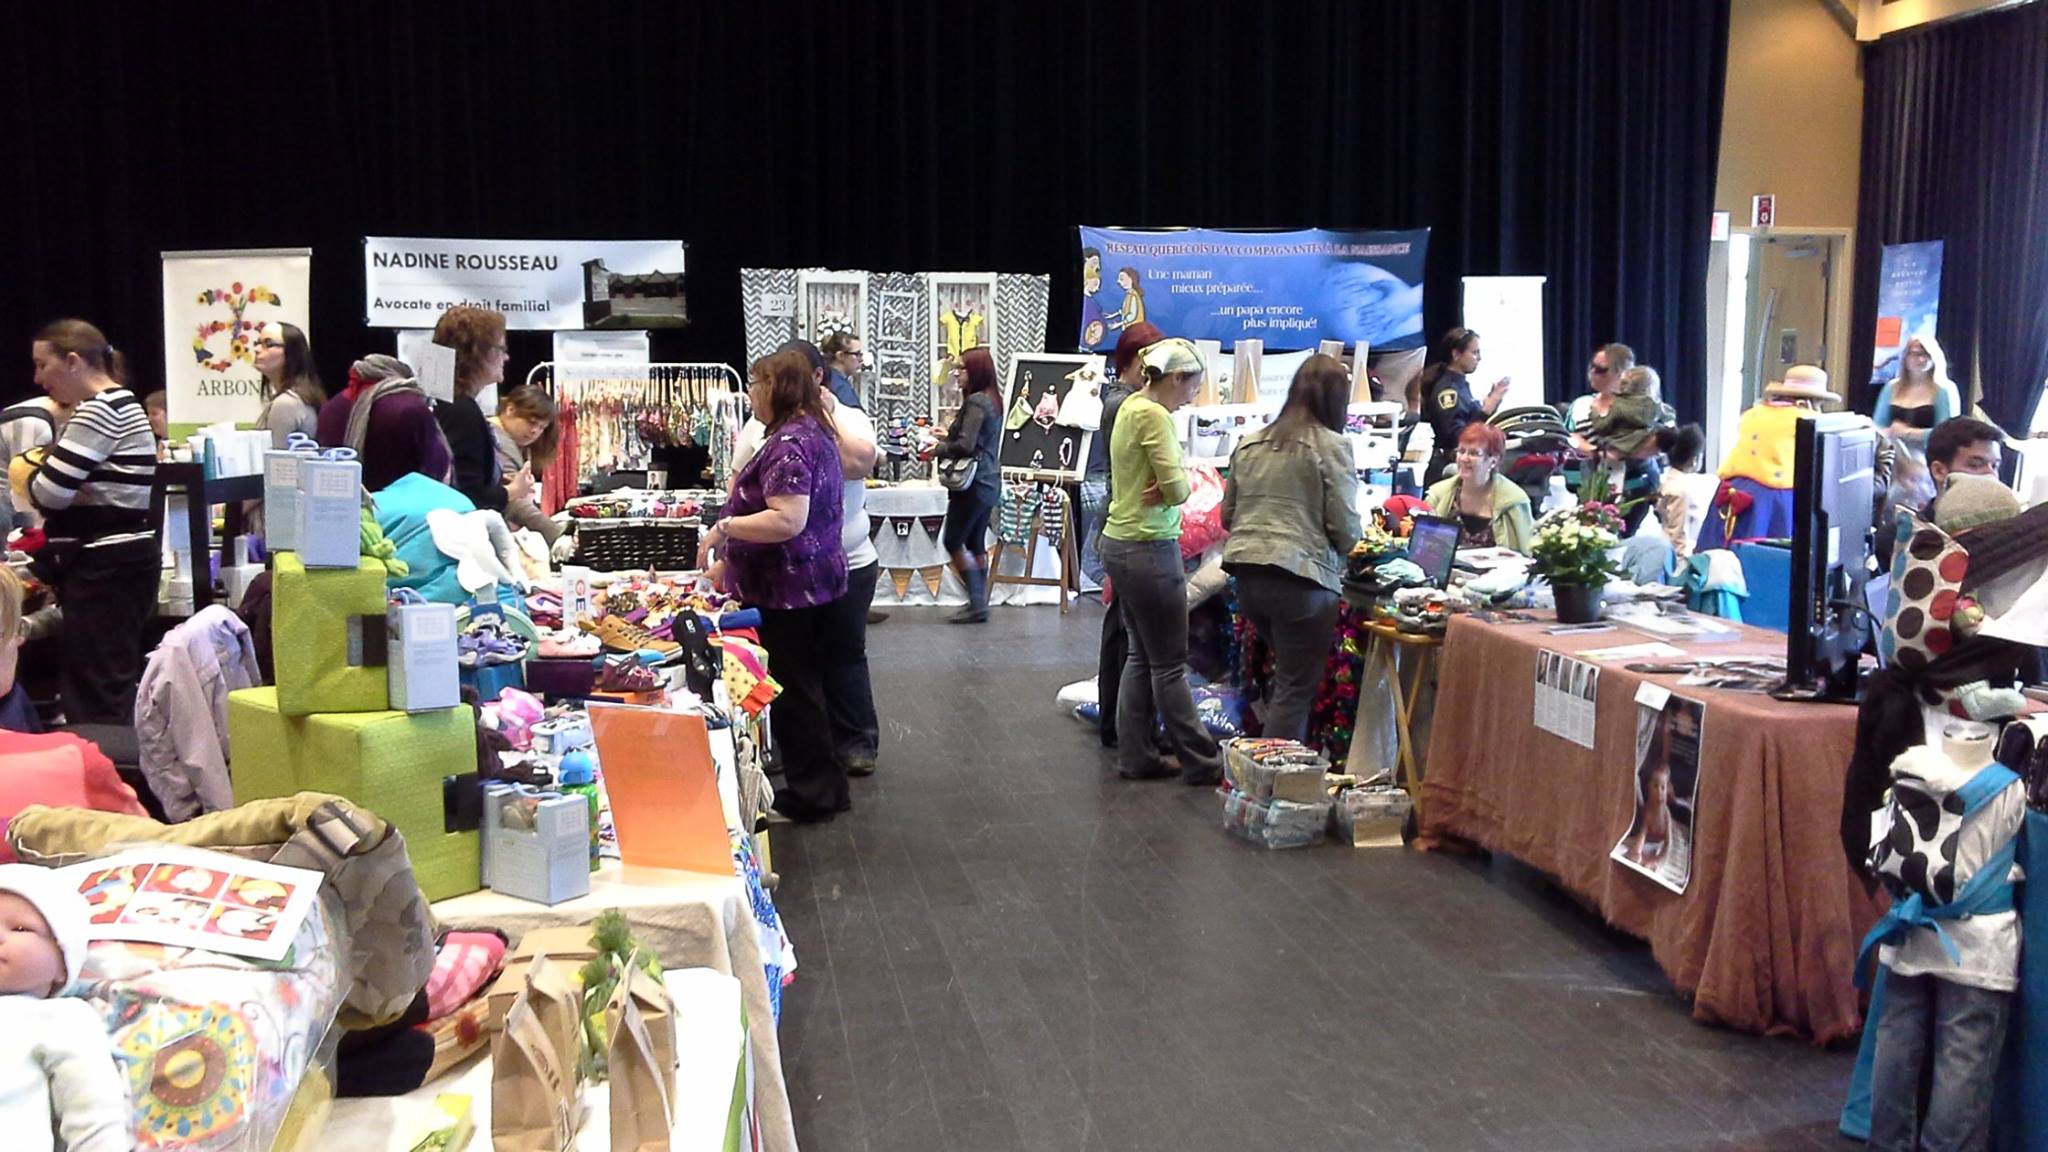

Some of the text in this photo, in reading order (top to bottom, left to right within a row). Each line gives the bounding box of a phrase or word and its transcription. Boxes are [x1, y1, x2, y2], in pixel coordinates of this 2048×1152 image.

[373, 252, 559, 271] NADINE ROUSSEAU
[1148, 269, 1212, 280] Une maman
[1171, 283, 1204, 294] mieux
[373, 298, 432, 310] Avocate
[495, 299, 551, 312] familial
[1236, 306, 1264, 317] papa
[1266, 306, 1303, 316] encore
[1243, 318, 1266, 330] plus
[197, 379, 262, 396] ARBON
